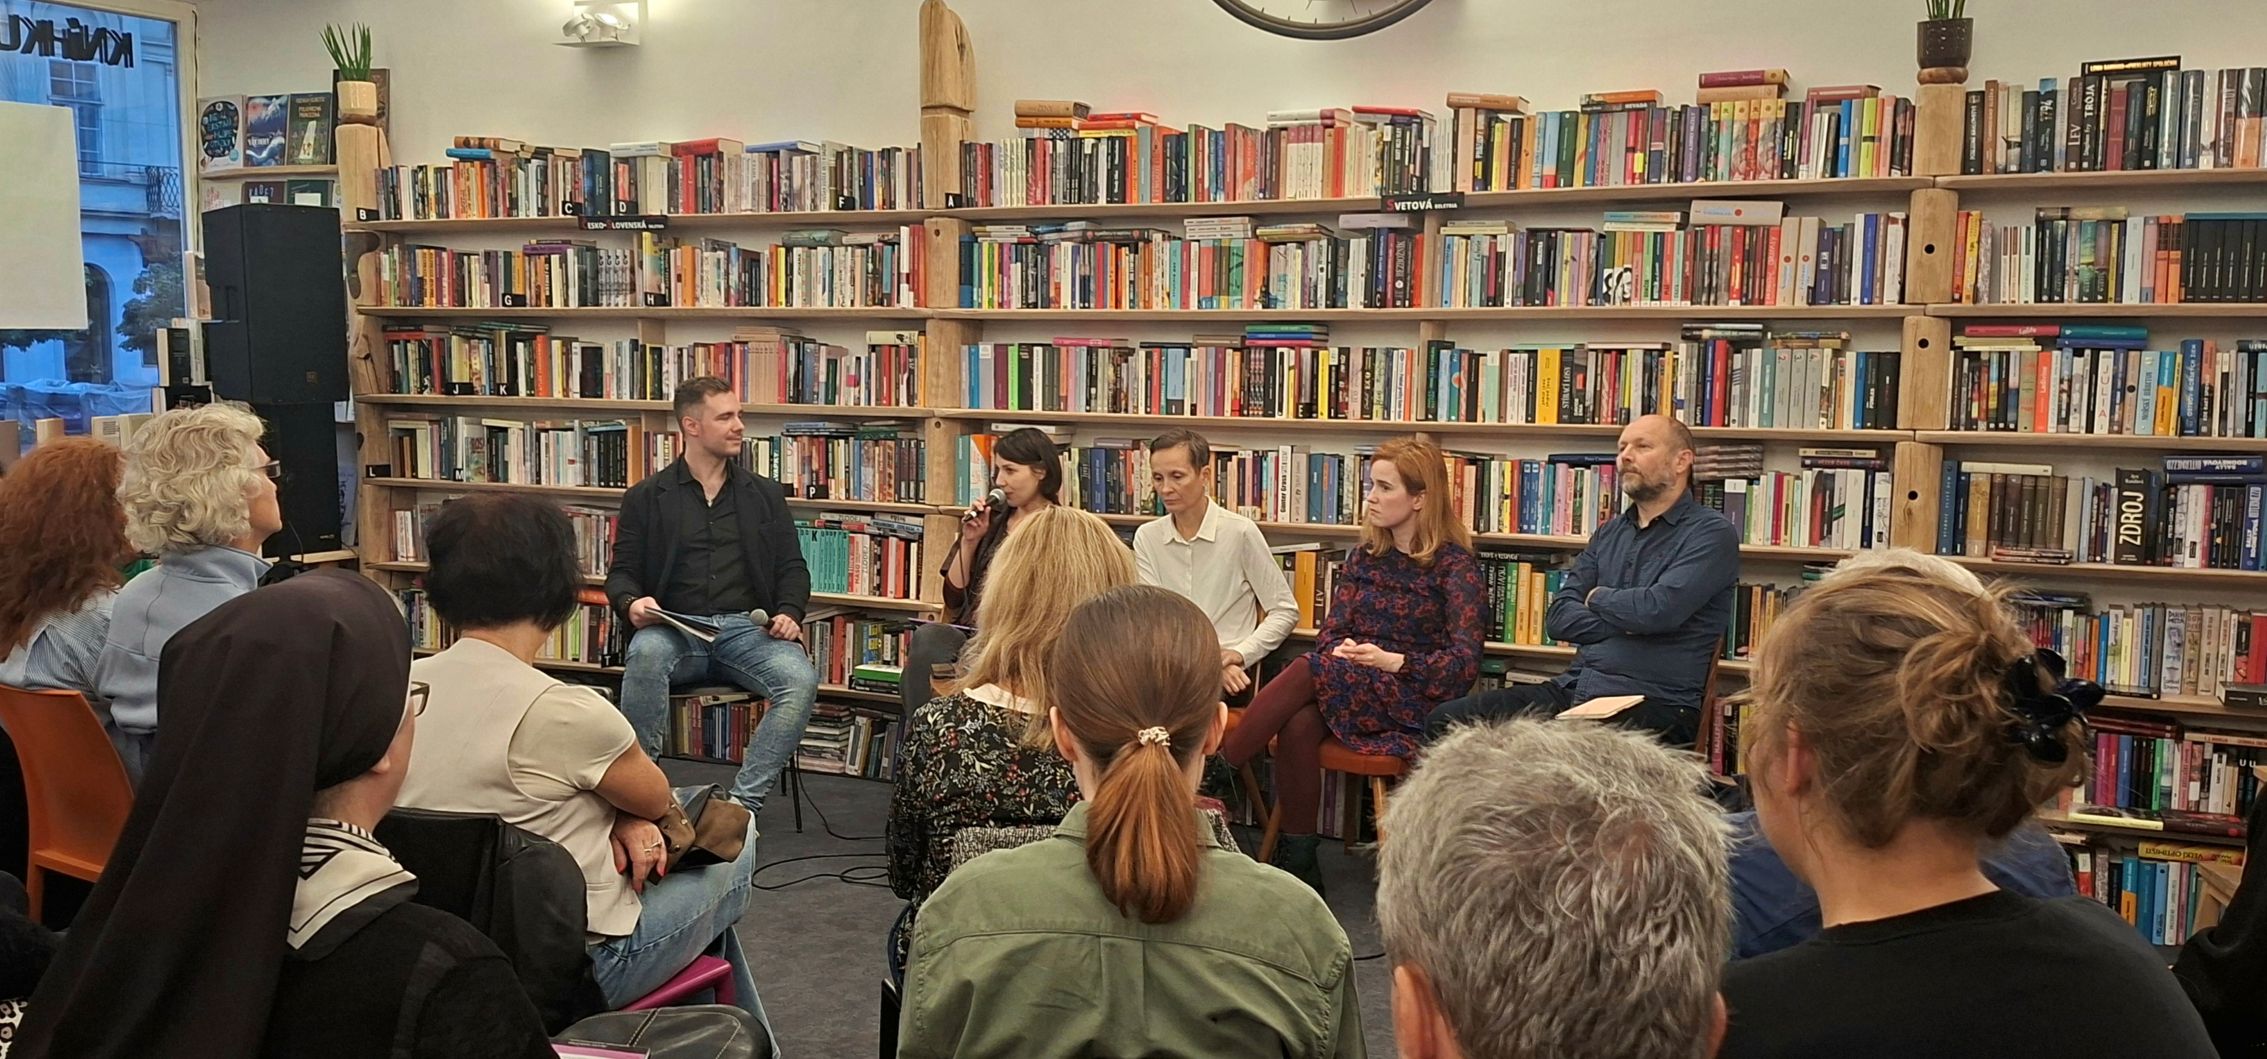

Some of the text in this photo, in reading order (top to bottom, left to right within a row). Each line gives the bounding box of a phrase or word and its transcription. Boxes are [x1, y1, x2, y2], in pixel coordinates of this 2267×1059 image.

[2068, 124, 2082, 146] LEV
[620, 201, 626, 212] D
[838, 196, 845, 208] F
[948, 196, 954, 208] A
[1386, 198, 1432, 212] SVETOVÁ
[359, 210, 366, 220] B
[564, 204, 572, 214] C
[504, 294, 512, 306] G
[647, 294, 655, 305] H
[453, 384, 460, 394] J
[499, 384, 508, 396] K
[2098, 366, 2110, 418] JULIA
[369, 466, 376, 477] L
[456, 470, 463, 480] M
[809, 486, 816, 498] P
[2118, 491, 2145, 546] ZDROJ
[1315, 591, 1324, 607] LEV
[604, 654, 610, 665] T
